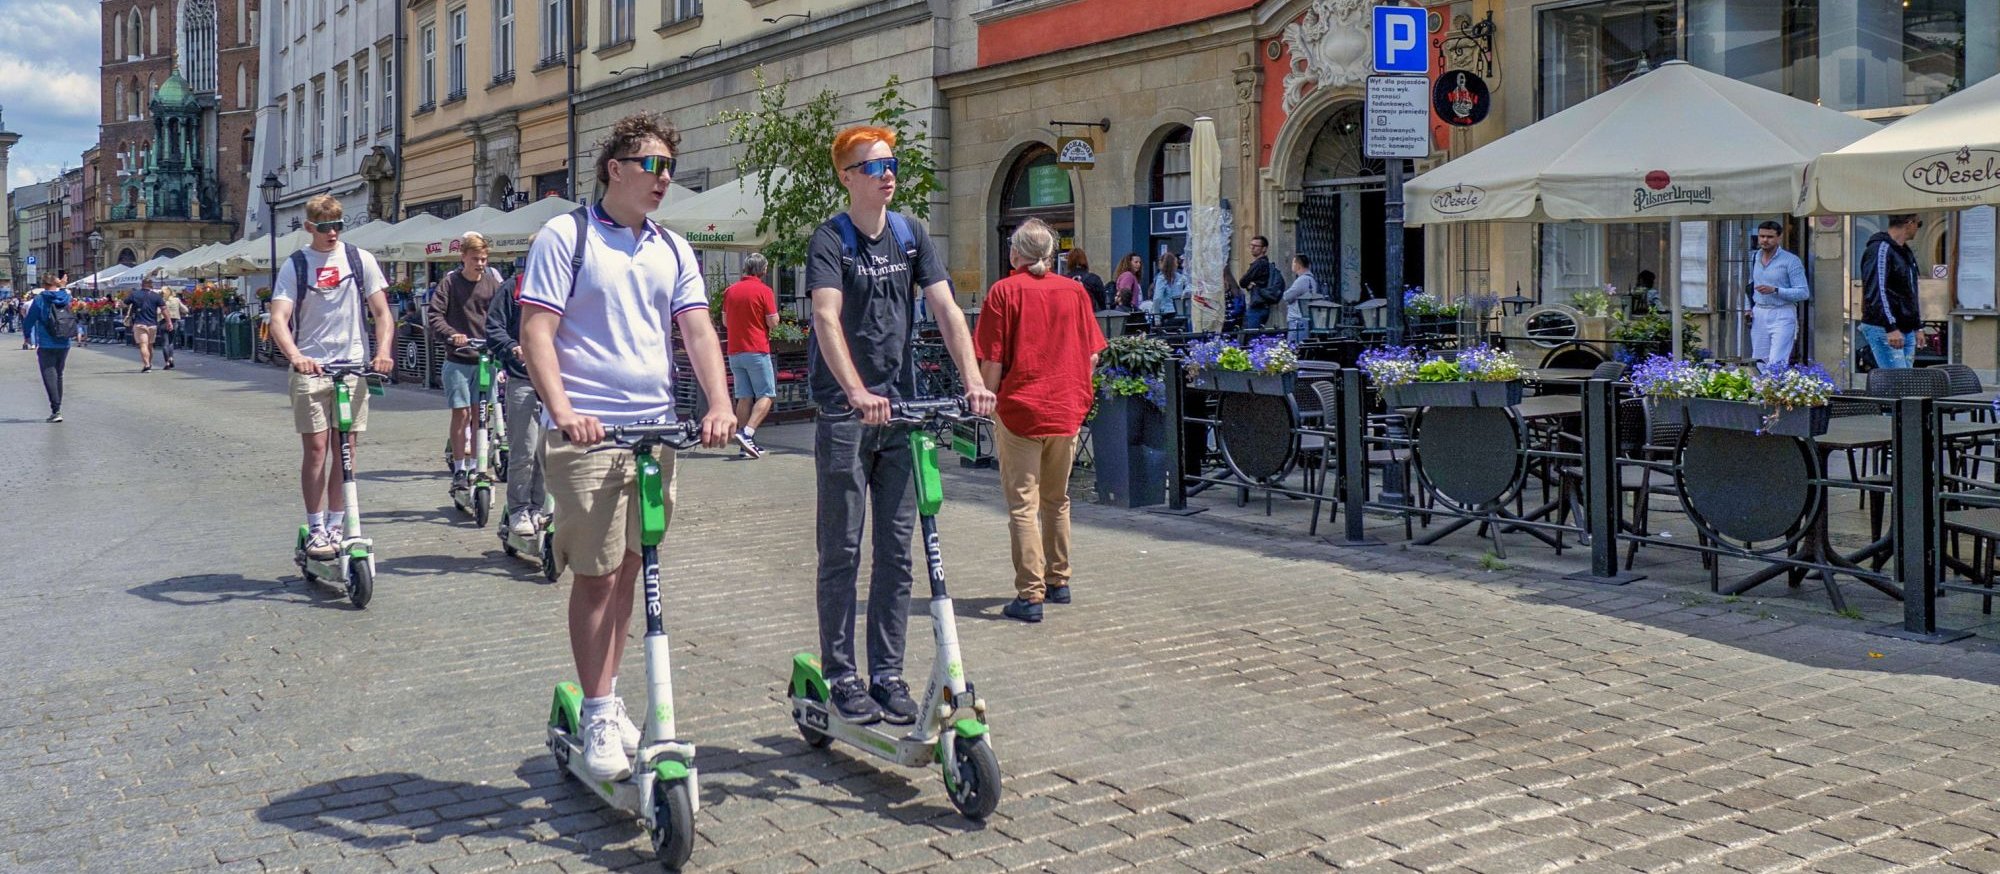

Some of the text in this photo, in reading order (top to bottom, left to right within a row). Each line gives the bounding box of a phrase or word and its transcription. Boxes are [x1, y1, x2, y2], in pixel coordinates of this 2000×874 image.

[1386, 14, 1416, 64] P
[1913, 157, 2000, 186] Wesele
[1434, 190, 1478, 208] Wesele
[1634, 184, 1711, 212] Pilsner Urquell
[686, 231, 734, 242] Heineken
[342, 443, 352, 471] Lime
[928, 533, 944, 581] Lime
[646, 564, 661, 616] Lime
